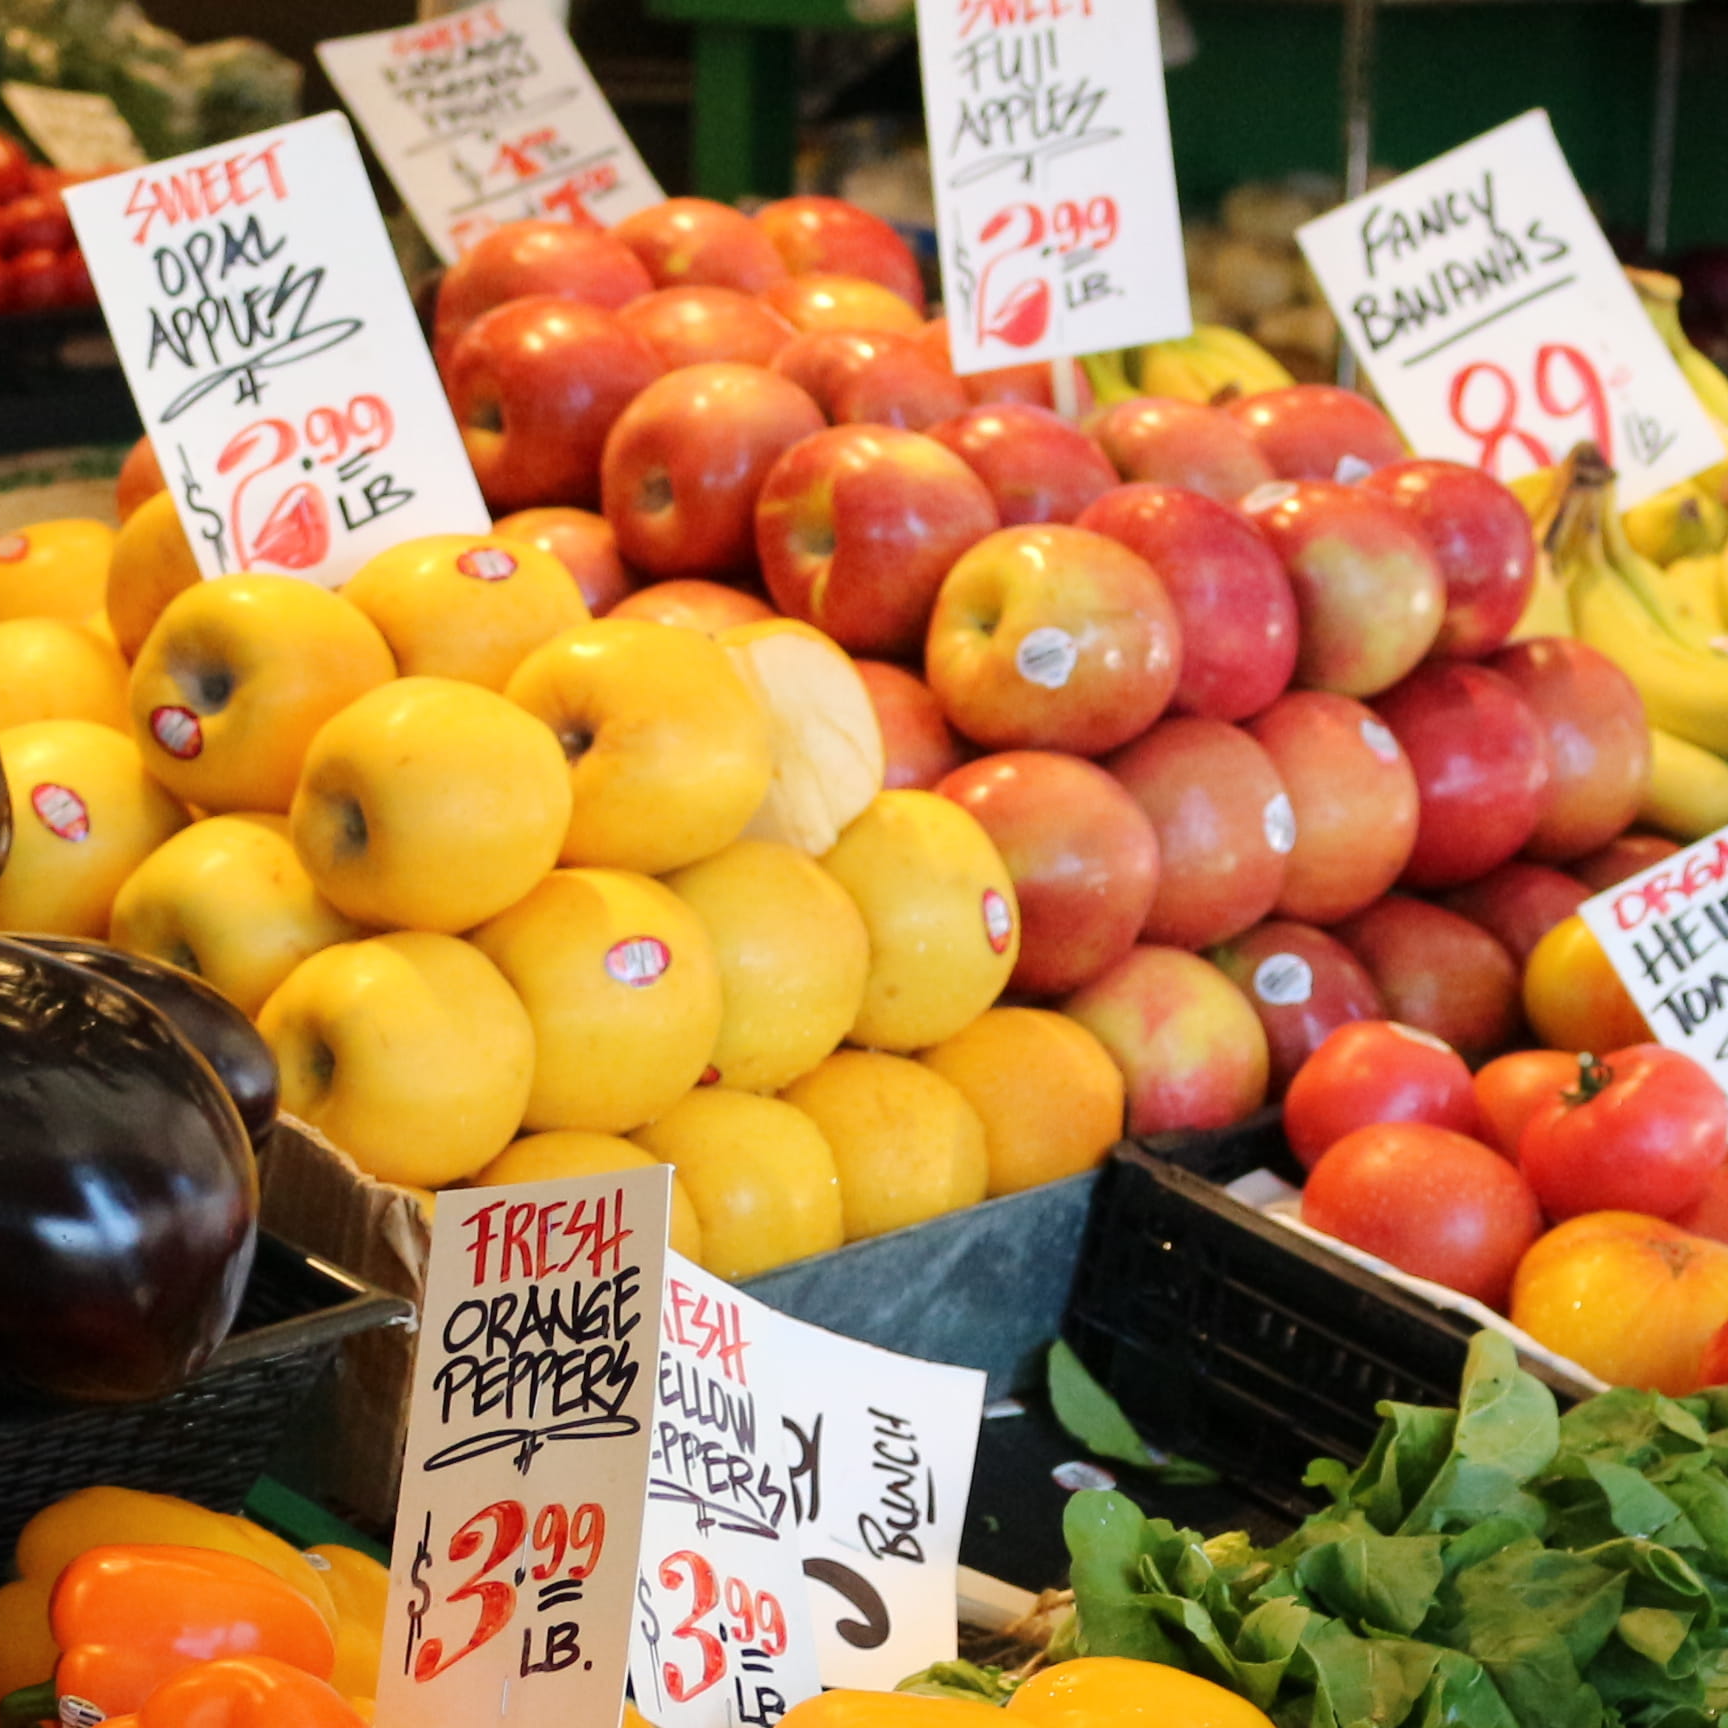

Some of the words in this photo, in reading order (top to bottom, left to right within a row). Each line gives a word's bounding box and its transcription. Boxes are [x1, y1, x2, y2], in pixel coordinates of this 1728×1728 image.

[952, 27, 1059, 95] FUJI
[949, 76, 1107, 160] APPLES
[122, 139, 290, 246] SWEET
[1359, 168, 1502, 279] FANCY
[152, 213, 288, 300] OPAL
[1352, 218, 1571, 352] BANANAS
[147, 262, 326, 371] APPLES
[176, 393, 395, 574] $2.99
[460, 1187, 635, 1289] FRESH
[441, 1264, 643, 1356] ORANGE
[433, 1339, 642, 1425] PEPPERS
[657, 1350, 757, 1455] ELLOW
[858, 1406, 926, 1565] BUNCH
[404, 1497, 607, 1685] $3.99
[638, 1547, 788, 1713] $3.99
[518, 1619, 594, 1680] LB.
